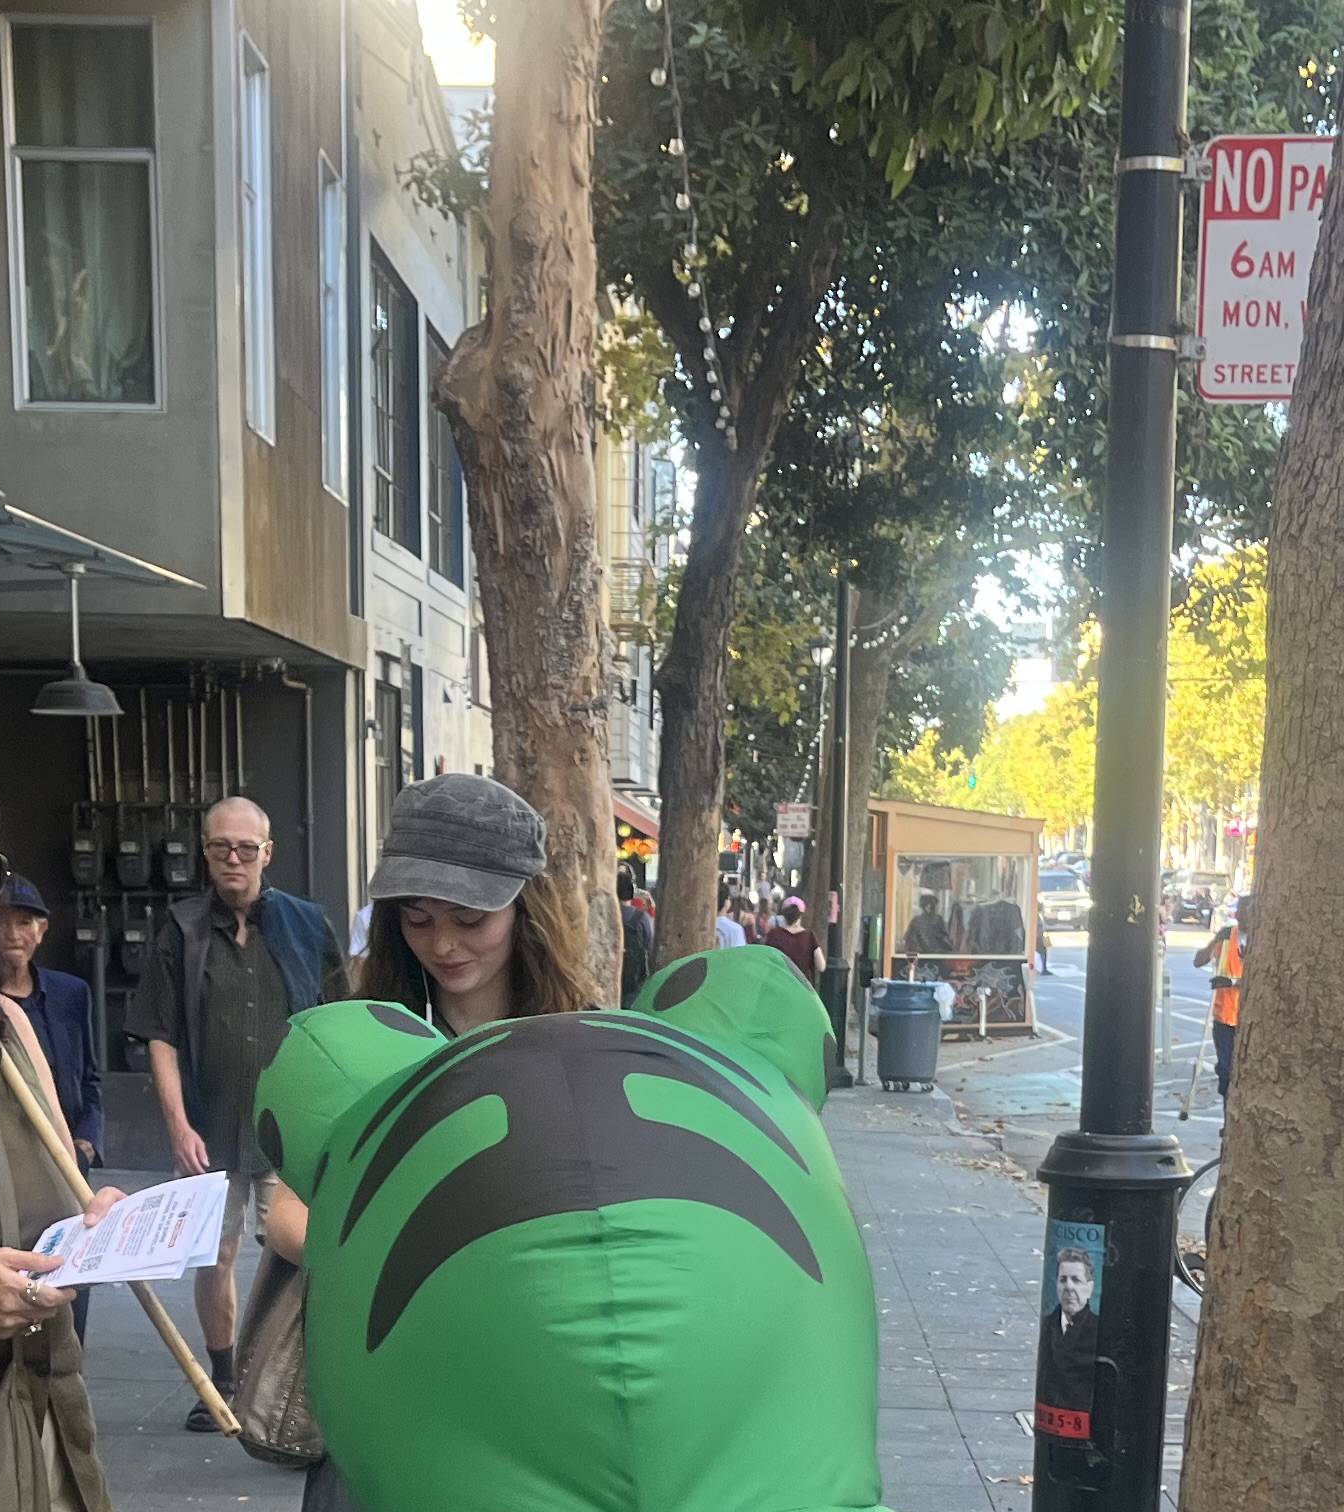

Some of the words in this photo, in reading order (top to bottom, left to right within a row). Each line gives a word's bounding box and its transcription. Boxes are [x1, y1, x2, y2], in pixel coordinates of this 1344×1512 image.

[1213, 148, 1275, 213] NO
[1230, 239, 1296, 279] 6AM
[1213, 363, 1296, 385] STREET
